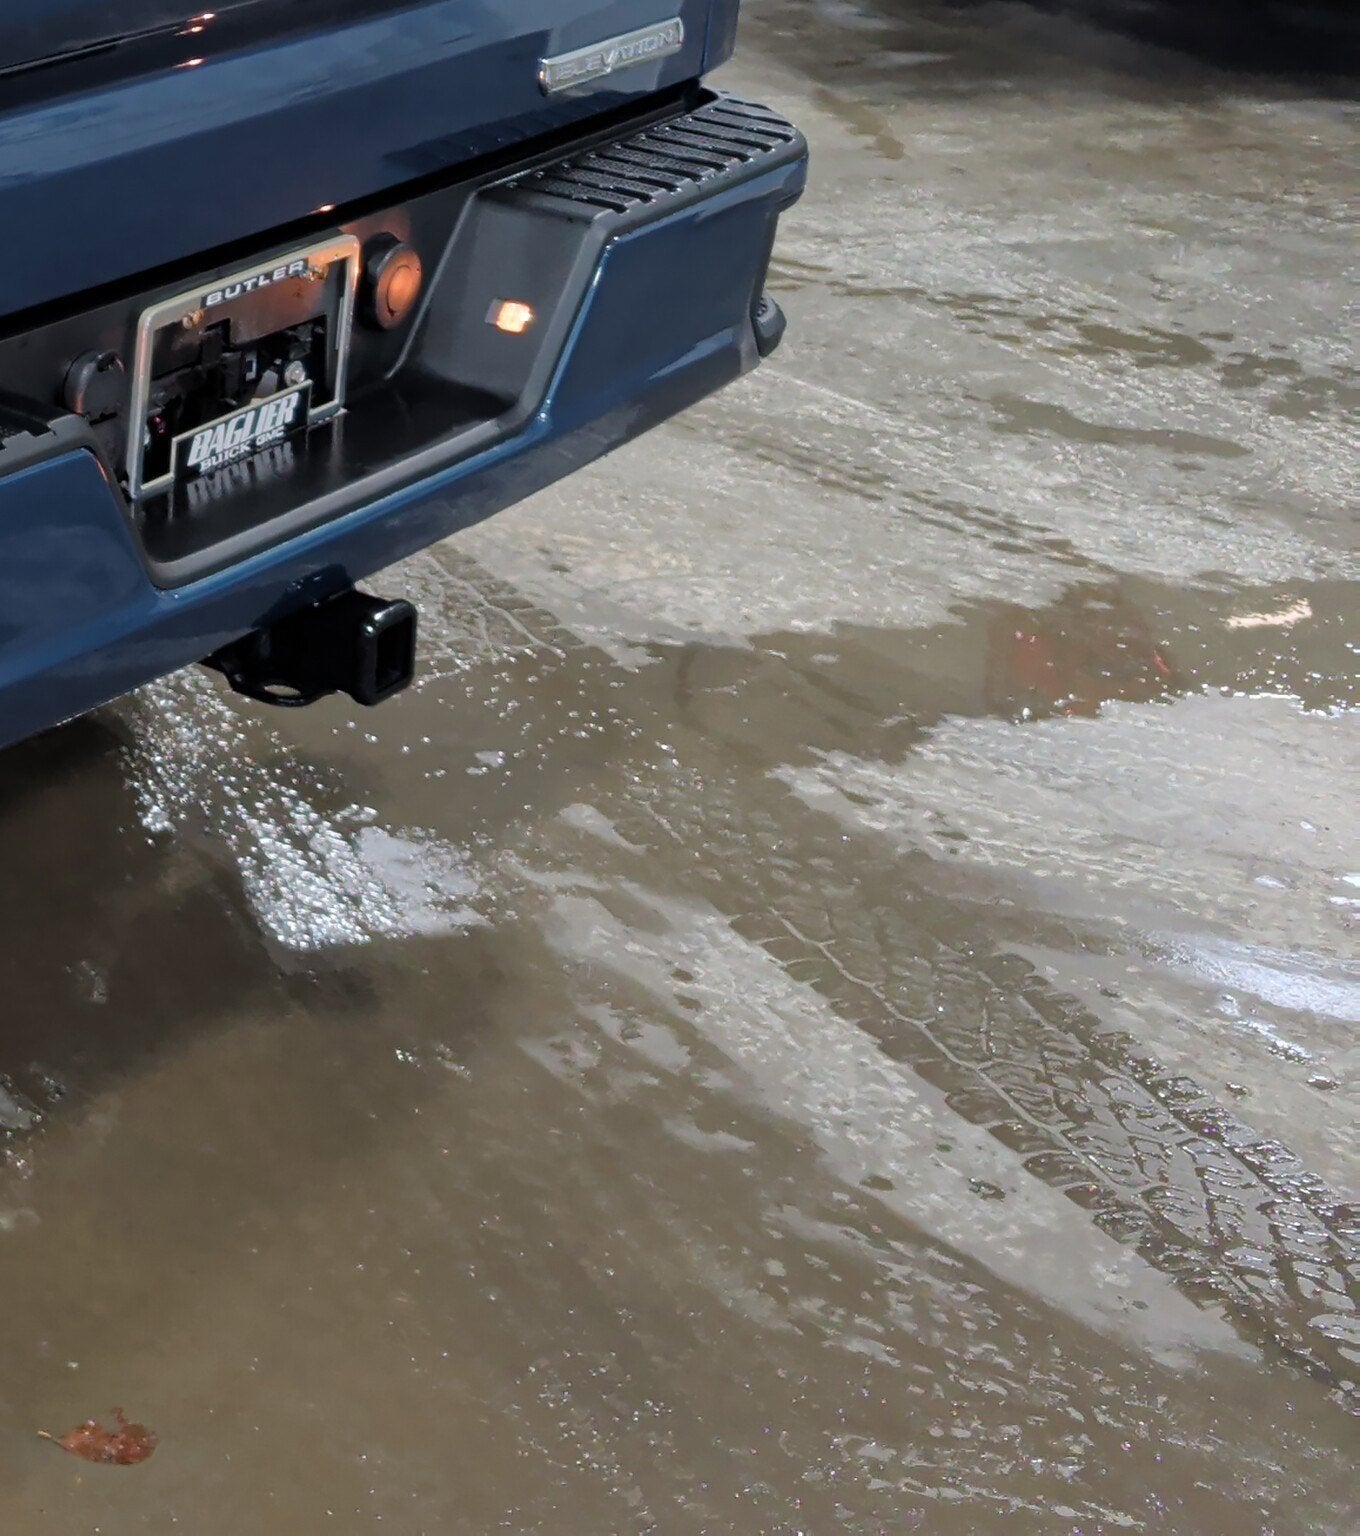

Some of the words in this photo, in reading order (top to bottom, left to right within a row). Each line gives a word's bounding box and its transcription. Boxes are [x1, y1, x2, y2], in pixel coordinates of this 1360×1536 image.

[205, 260, 306, 306] BUTLER
[186, 391, 300, 467] BAGLIER
[199, 439, 252, 472] BUICK
[255, 425, 286, 446] GMC
